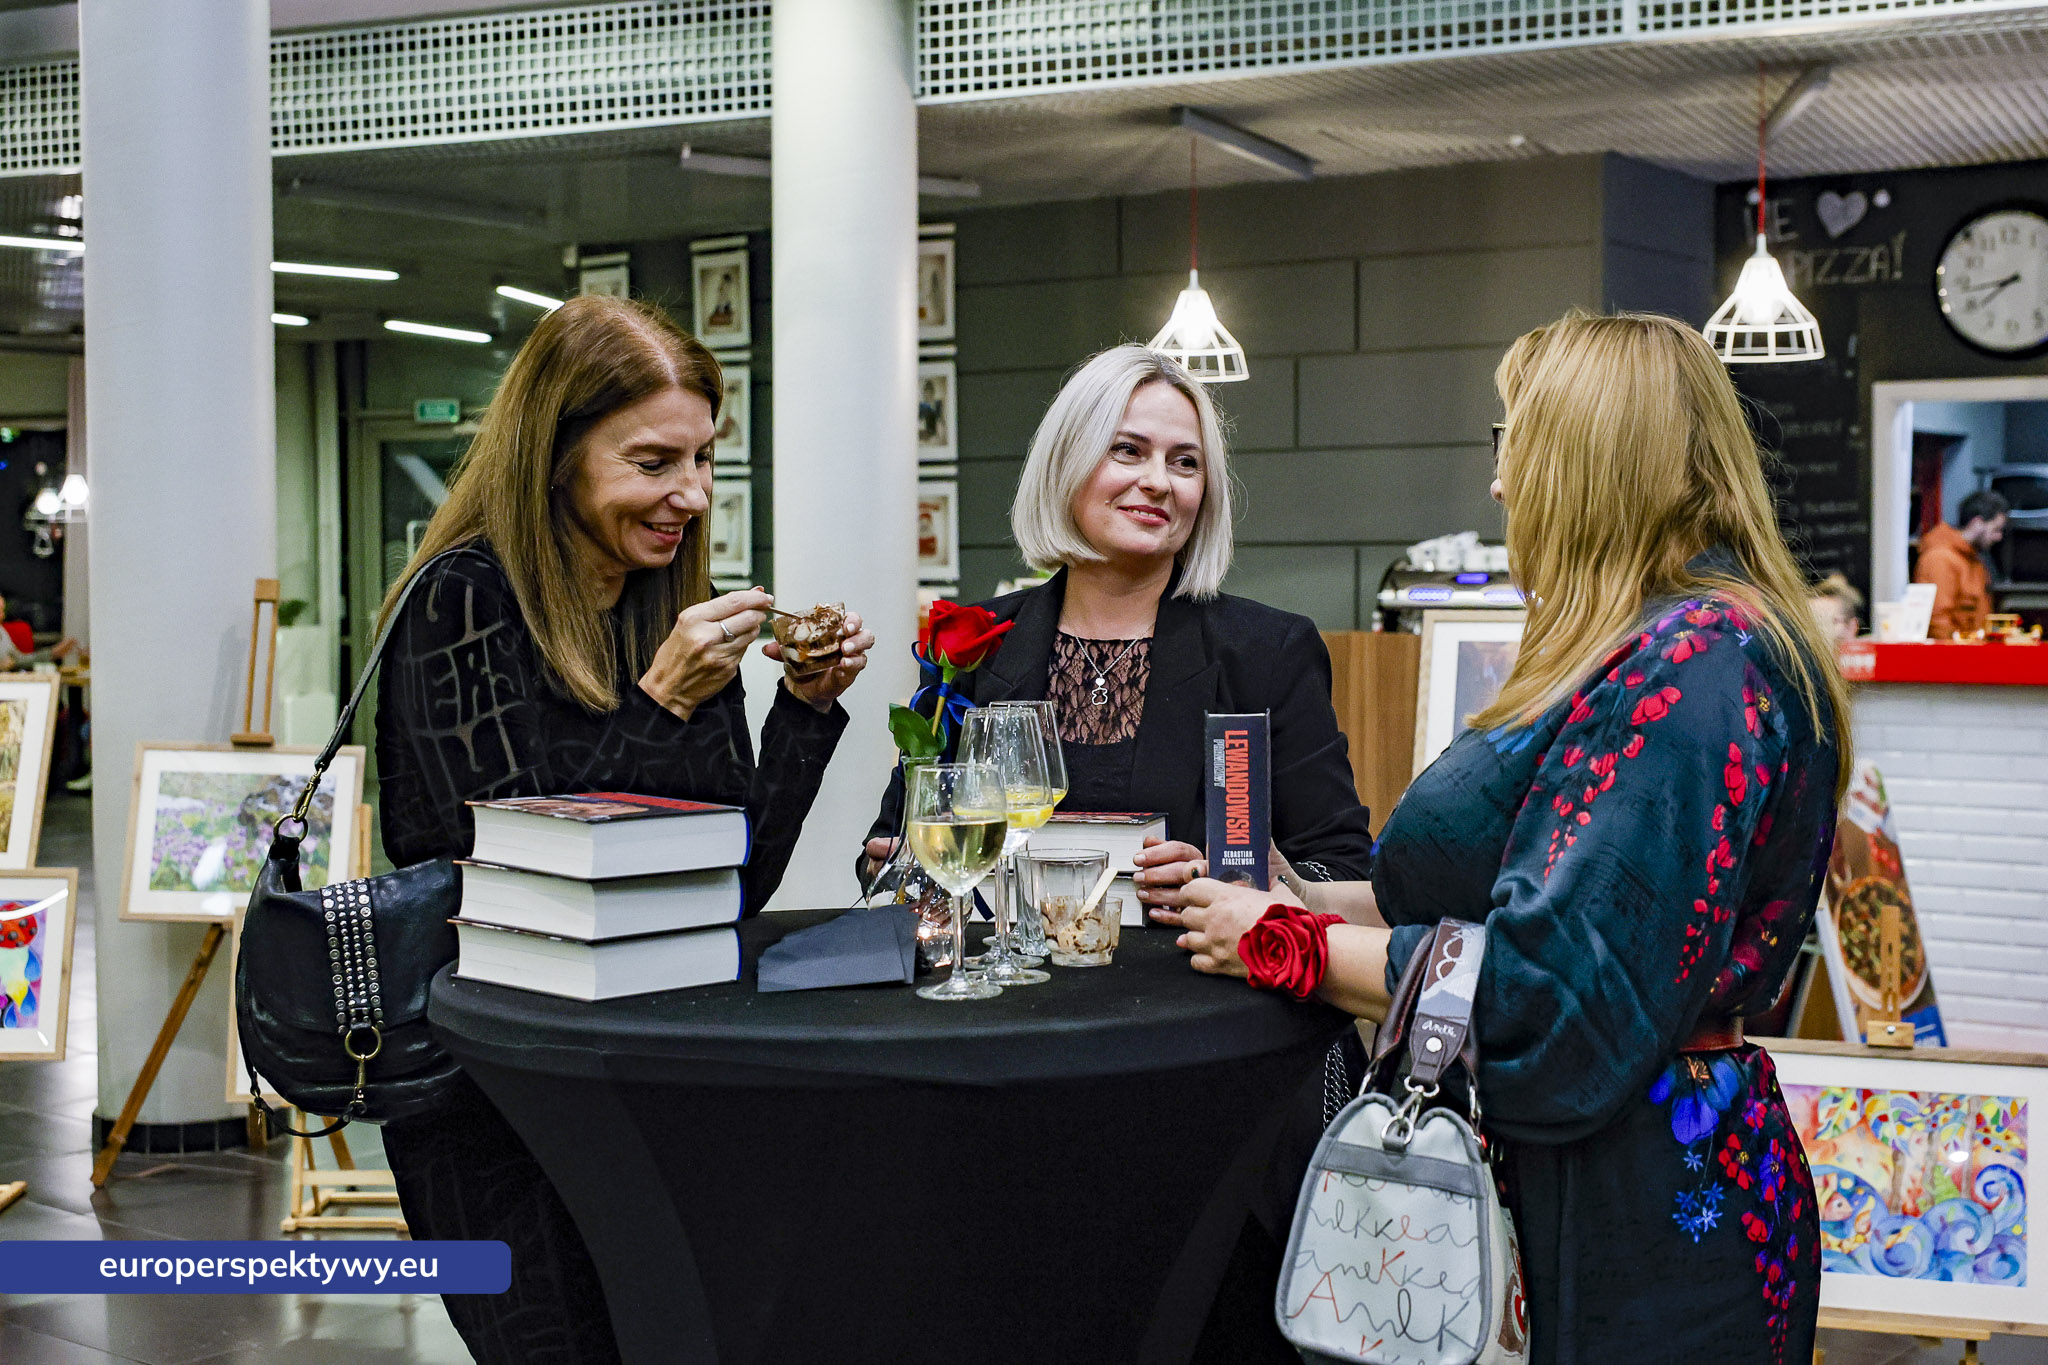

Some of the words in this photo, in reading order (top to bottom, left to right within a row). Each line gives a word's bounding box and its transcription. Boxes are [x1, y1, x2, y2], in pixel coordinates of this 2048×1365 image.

[1787, 231, 1907, 288] PIZZA!
[1225, 730, 1250, 845] LEWANDOWSKI
[1223, 850, 1253, 858] SEBASTIAN
